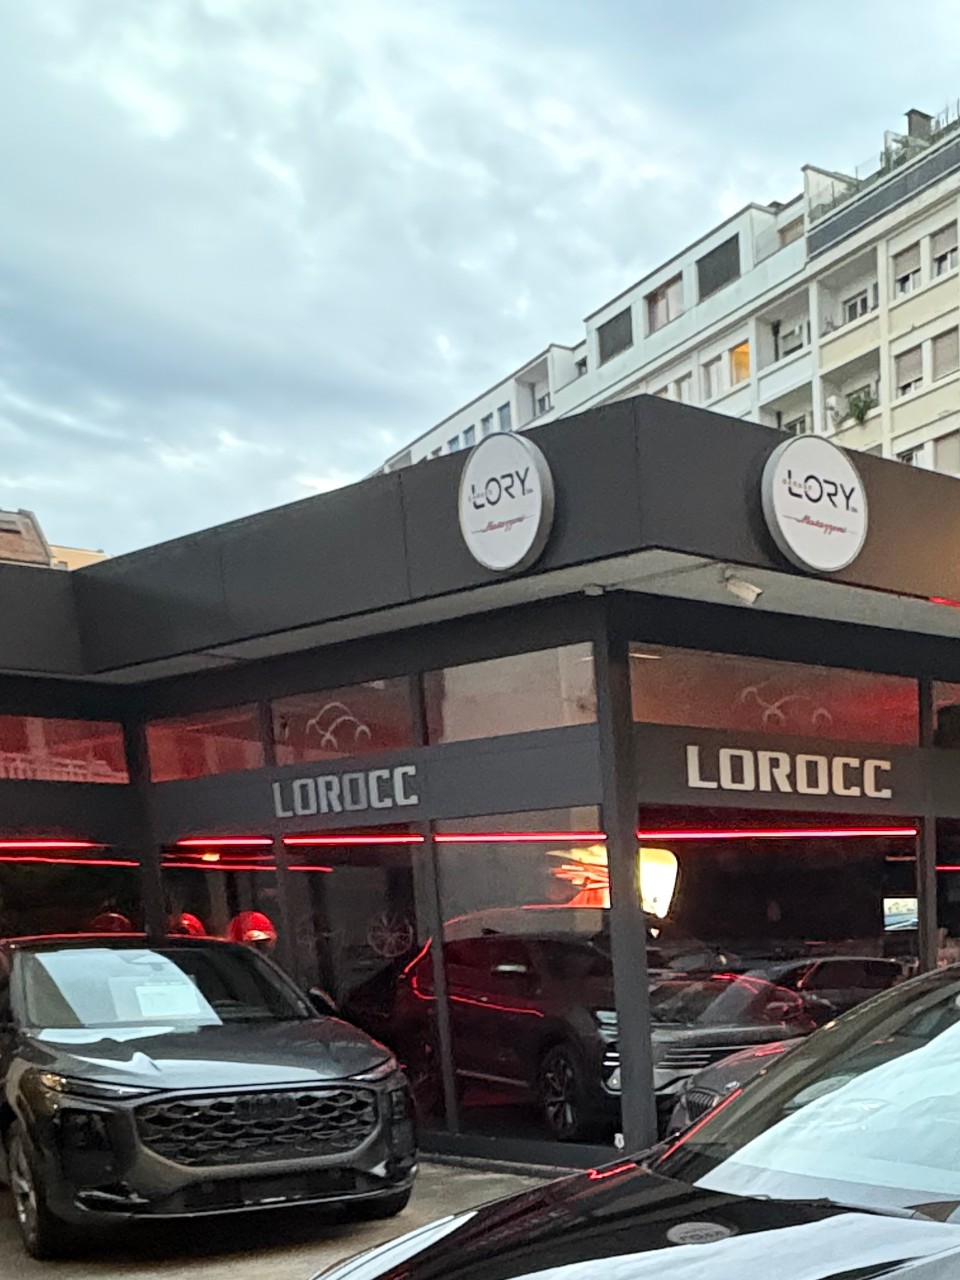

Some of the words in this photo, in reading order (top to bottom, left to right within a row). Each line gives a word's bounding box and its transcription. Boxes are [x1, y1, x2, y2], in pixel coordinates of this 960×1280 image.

[471, 466, 530, 510] LORY
[787, 469, 855, 511] LORY
[272, 765, 419, 818] LOROCC
[686, 745, 893, 799] LOROCC
